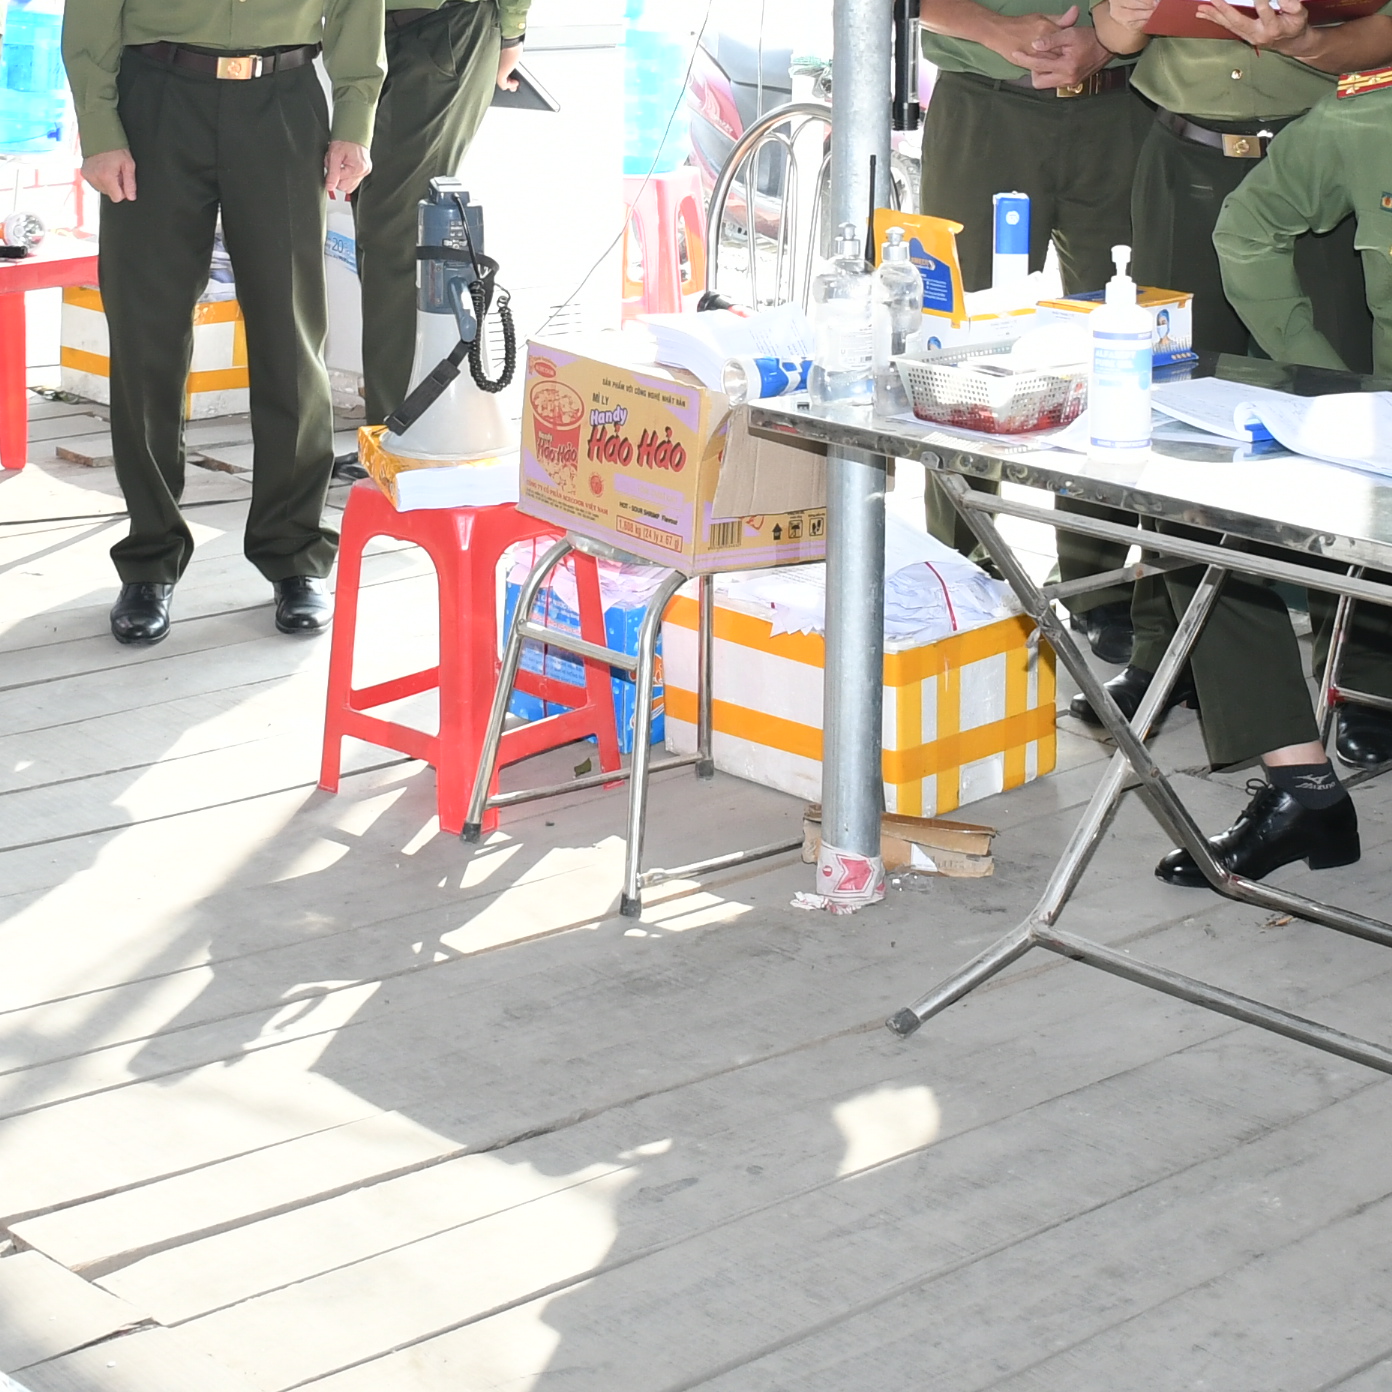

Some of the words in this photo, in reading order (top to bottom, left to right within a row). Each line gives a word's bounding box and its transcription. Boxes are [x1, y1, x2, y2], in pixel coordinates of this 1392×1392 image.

[590, 404, 628, 427] Handy
[587, 422, 634, 467] Hảo
[637, 426, 686, 473] Hảo
